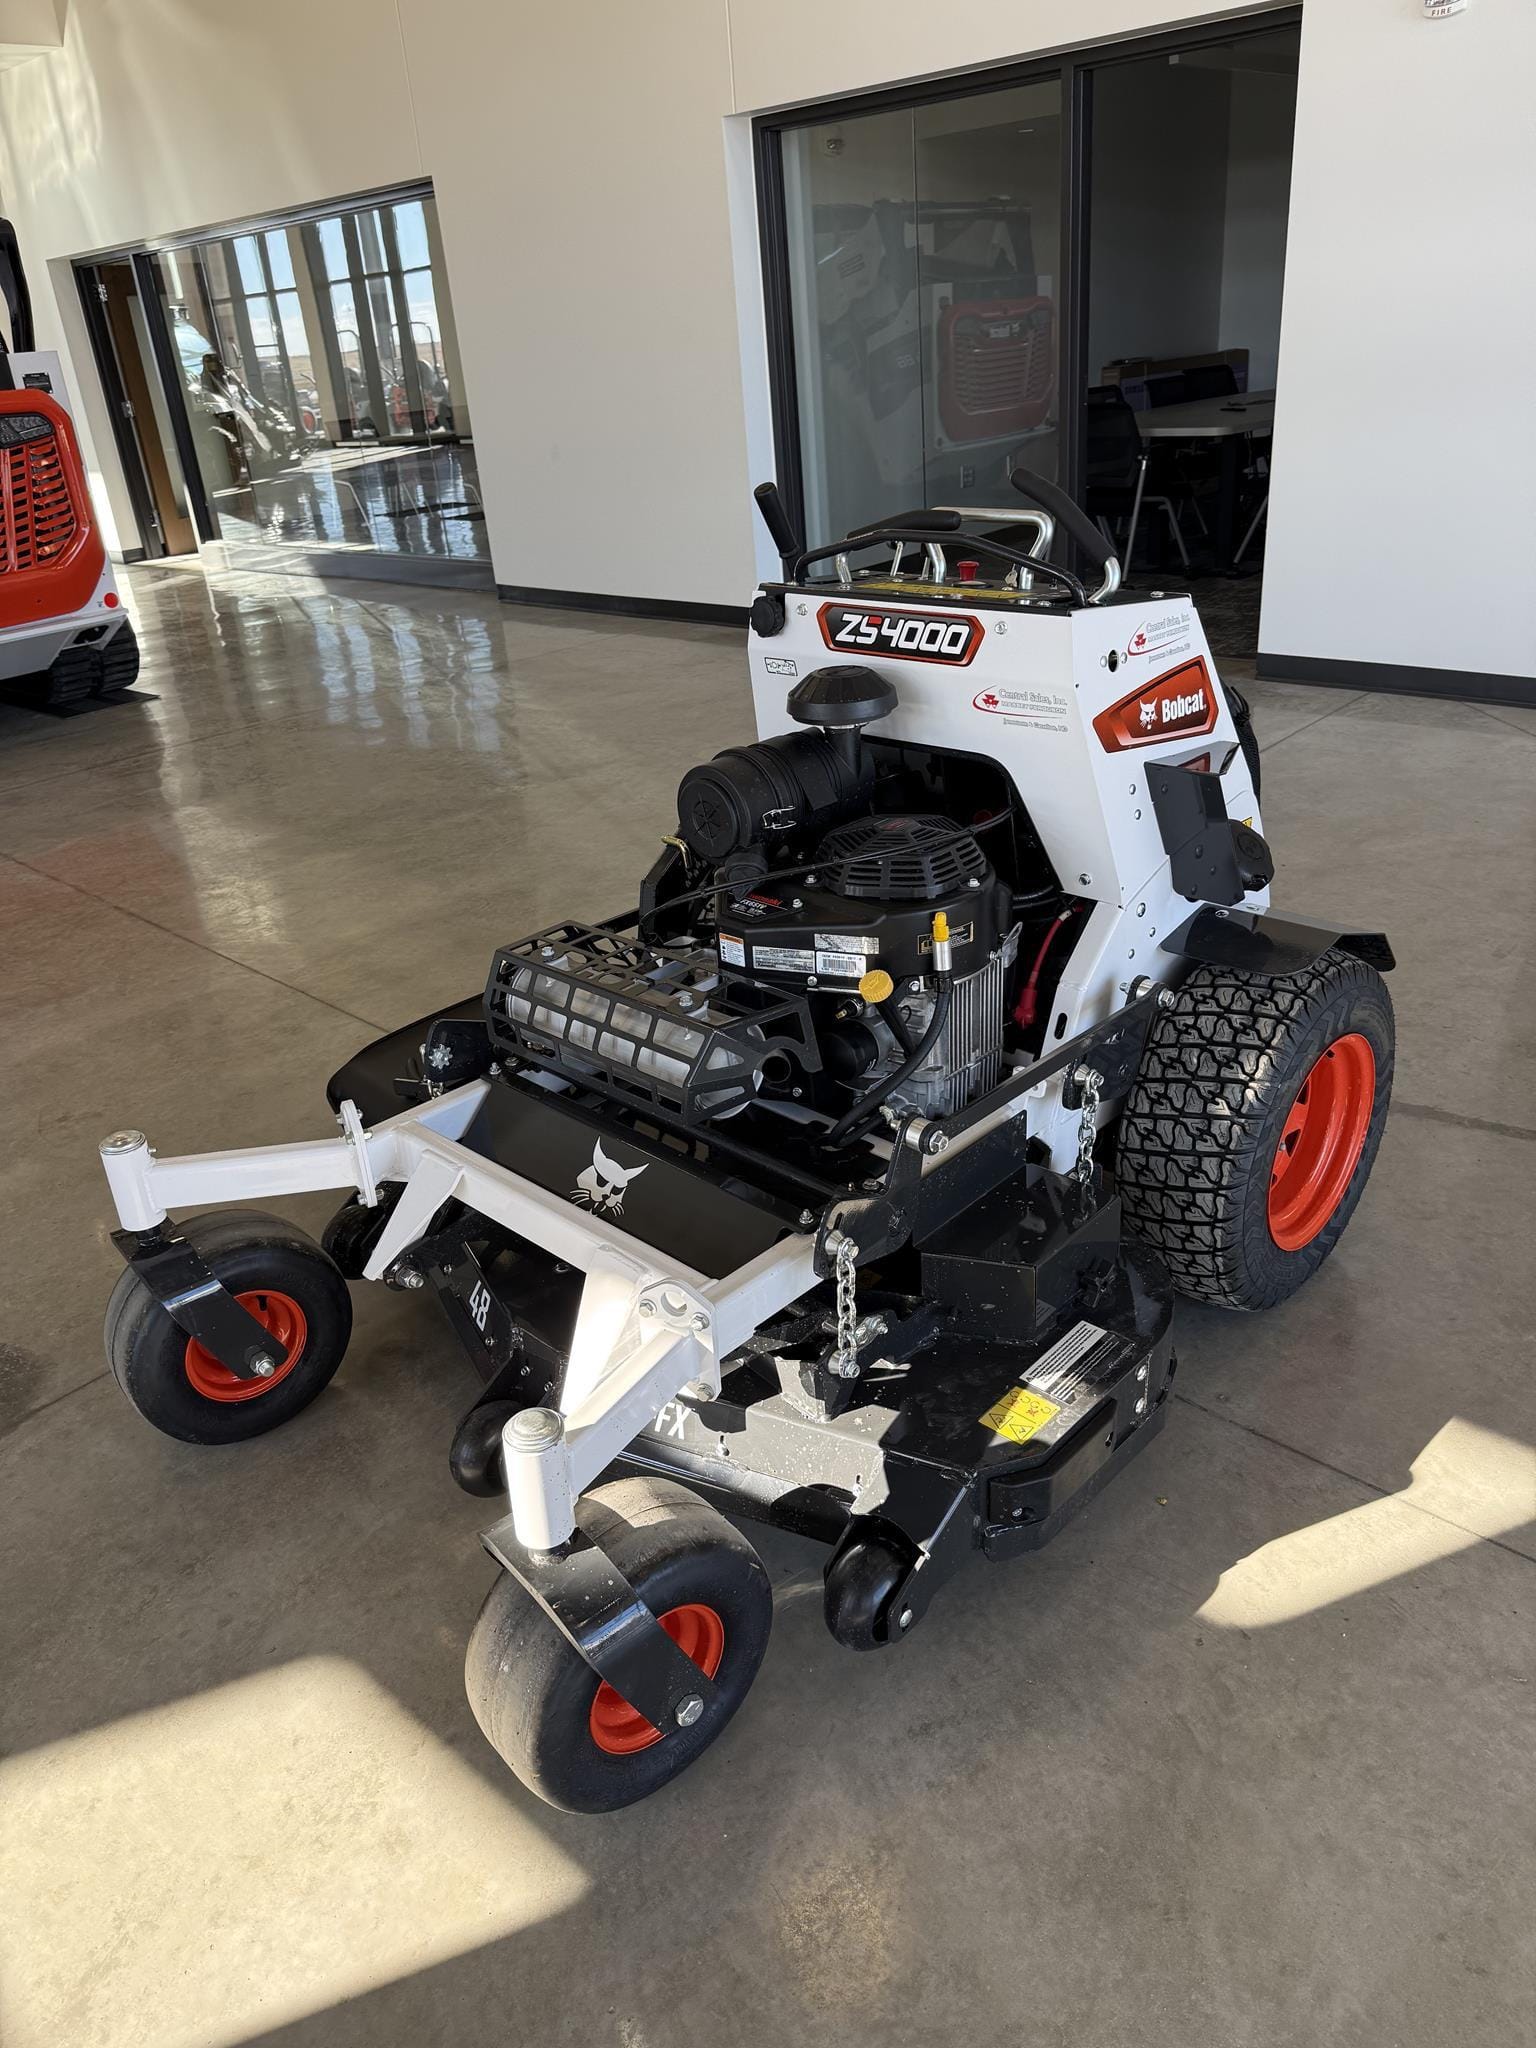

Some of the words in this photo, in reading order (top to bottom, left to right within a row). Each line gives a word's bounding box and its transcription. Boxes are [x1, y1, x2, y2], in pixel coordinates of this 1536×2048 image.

[1431, 7, 1452, 16] FIRE
[835, 613, 970, 655] ZS4000
[1162, 688, 1204, 723] Bobcat
[469, 1280, 491, 1332] 48
